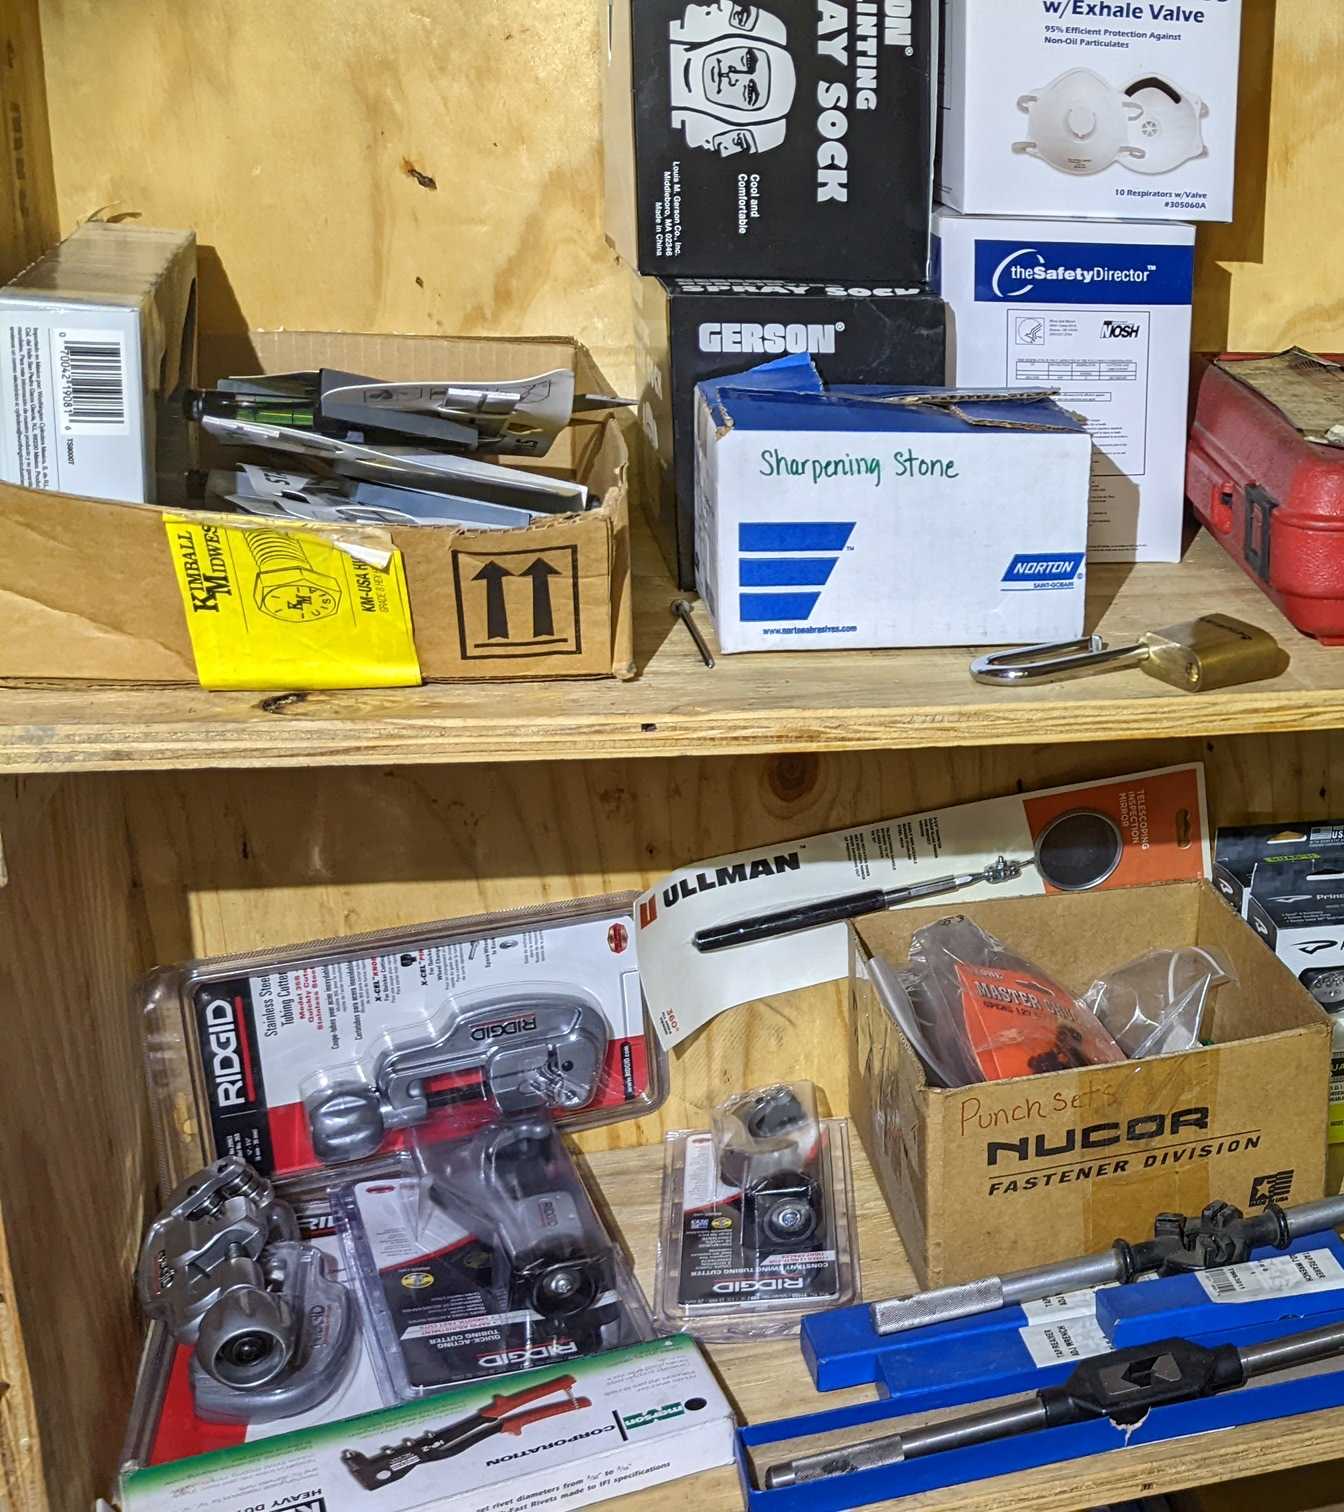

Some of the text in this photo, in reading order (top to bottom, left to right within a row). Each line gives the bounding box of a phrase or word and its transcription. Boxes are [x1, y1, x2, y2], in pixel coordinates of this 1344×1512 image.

[1149, 1, 1205, 23] Valve
[1044, 25, 1182, 42] 95% Efficient Protection Against
[1044, 36, 1130, 50] Non-Oil Particulates
[817, 81, 848, 202] SOCK
[673, 161, 682, 256] Louis M. Gerson Co., Inc.
[738, 173, 747, 234] Comfortable
[751, 174, 760, 217] Cool and
[1115, 188, 1208, 200] 10 Respirators w/Valve
[1164, 201, 1206, 210] #305060A
[655, 202, 663, 223] Made
[663, 171, 673, 256] Middleboro, MA 02346
[682, 285, 810, 295] SPRAY
[699, 322, 836, 353] GERSON
[1100, 324, 1140, 339] NIOSH
[60, 350, 71, 379] 70042
[62, 385, 73, 414] 19081
[759, 448, 960, 487] Sharpening Stone
[178, 530, 220, 613] KIMBALL
[201, 524, 232, 597] MIDWES
[1013, 560, 1075, 576] NORTON
[354, 571, 376, 612] KM-USA
[762, 625, 858, 636] www.nortonabrasives.com
[1119, 792, 1130, 828] MIRROR
[1128, 791, 1140, 844] INSPECTION
[1137, 788, 1150, 850] TELESCOPING
[663, 851, 801, 909] ULLMAN
[420, 965, 428, 986] X-CEL
[372, 980, 382, 1002] X-CEL
[973, 981, 1042, 1010] MASTER
[262, 997, 278, 1038] Stainless
[279, 998, 294, 1027] Tubing
[304, 991, 315, 1023] Quickly
[471, 1018, 537, 1042] RIDGID
[206, 998, 247, 1108] RIDGID
[960, 1095, 1046, 1137] Punch
[986, 1106, 1210, 1167] NUCOR
[988, 1134, 1263, 1197] FASTENER DIVISION
[691, 1268, 725, 1277] CUTTER
[728, 1266, 759, 1276] TUBING
[1295, 1263, 1313, 1282] WRENCH
[1310, 1260, 1327, 1279] REAMER
[712, 1277, 804, 1293] RIDGID
[429, 1329, 498, 1345] TUBING CUTTER
[436, 1334, 501, 1349] QUICK-ACTING
[1044, 1330, 1061, 1349] REAMER
[1057, 1325, 1077, 1347] WRENCH
[477, 1341, 578, 1368] RIDGID
[486, 1424, 617, 1467] CORPORATION
[272, 1488, 323, 1508] HEAVY
[492, 1469, 615, 1511] rivet diameters from to
[530, 1496, 558, 1510] Rivets
[561, 1487, 585, 1500] made
[587, 1483, 597, 1491] to
[613, 1461, 671, 1483] specifications
